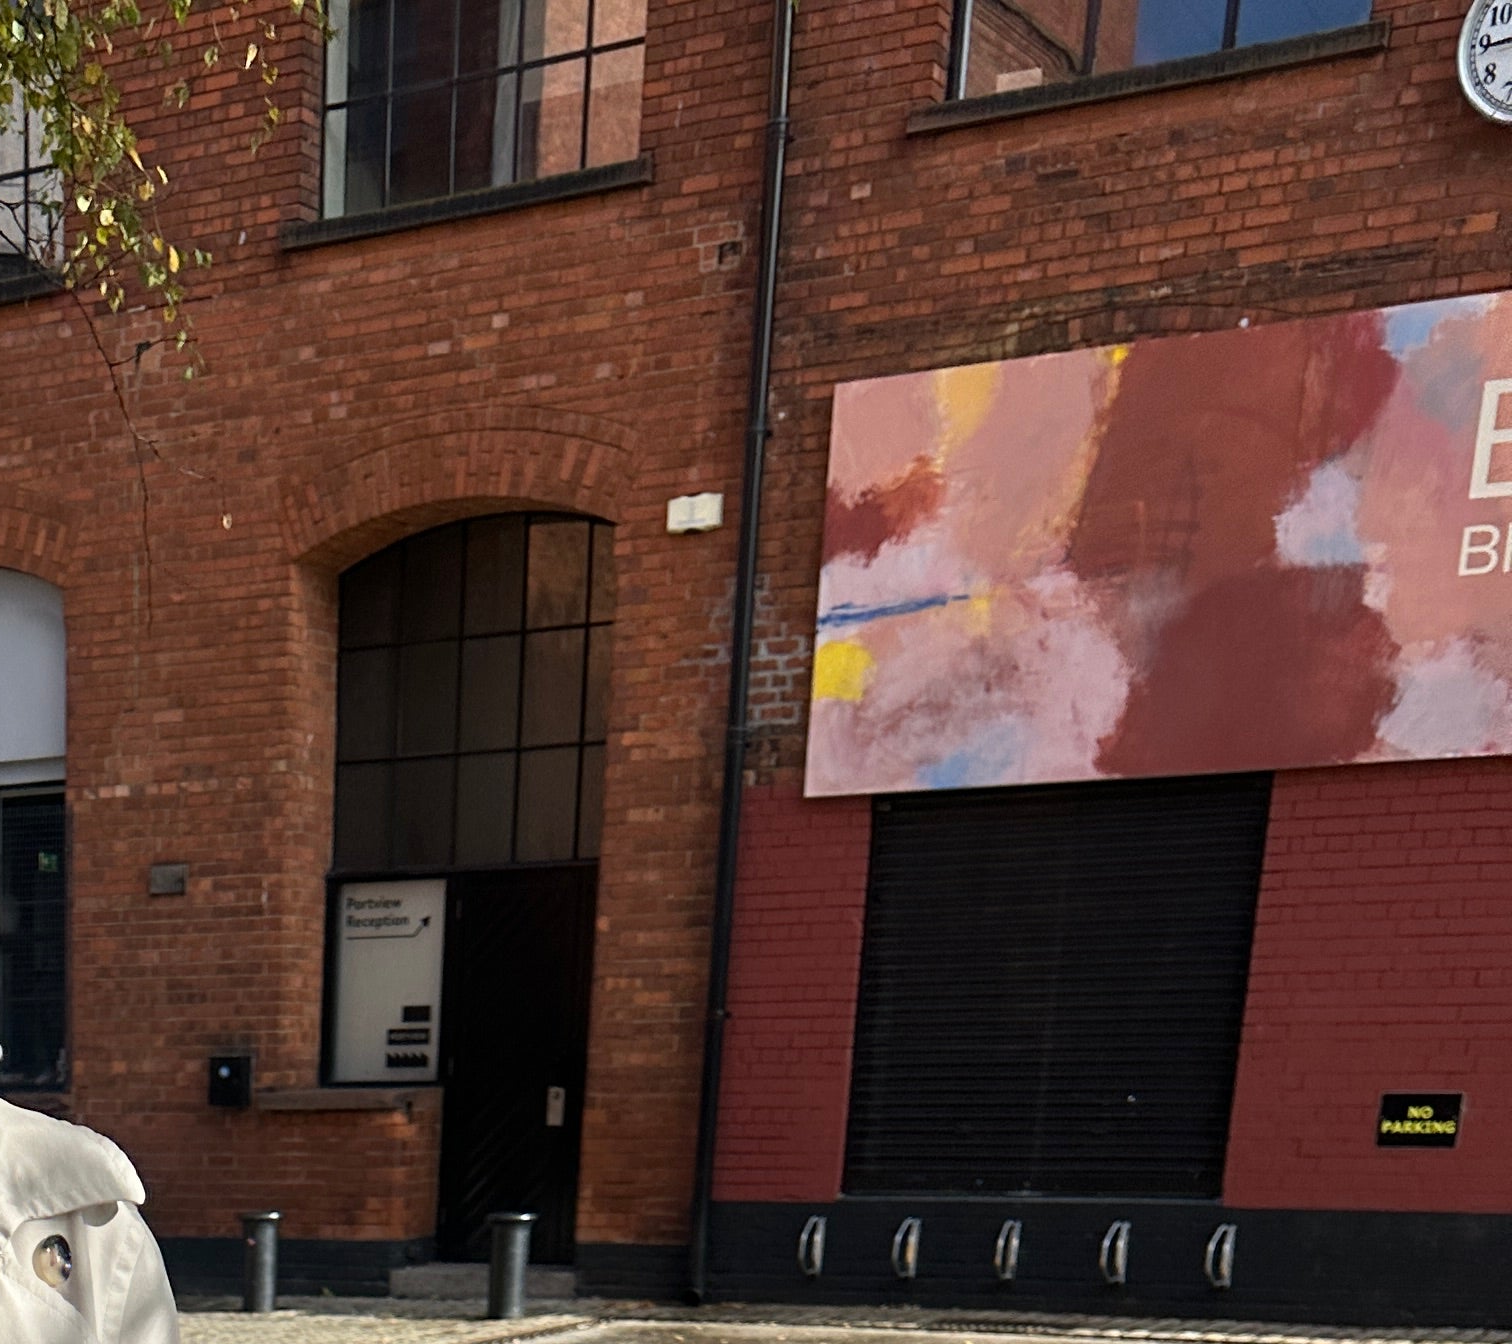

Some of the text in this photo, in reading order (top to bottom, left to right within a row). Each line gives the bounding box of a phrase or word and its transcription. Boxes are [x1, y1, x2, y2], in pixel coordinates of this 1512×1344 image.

[1490, 3, 1512, 26] 10
[1478, 34, 1491, 55] 9
[1484, 62, 1496, 85] 8
[346, 914, 410, 930] Reception
[1407, 1105, 1434, 1119] NO
[1380, 1120, 1457, 1135] PARKING
